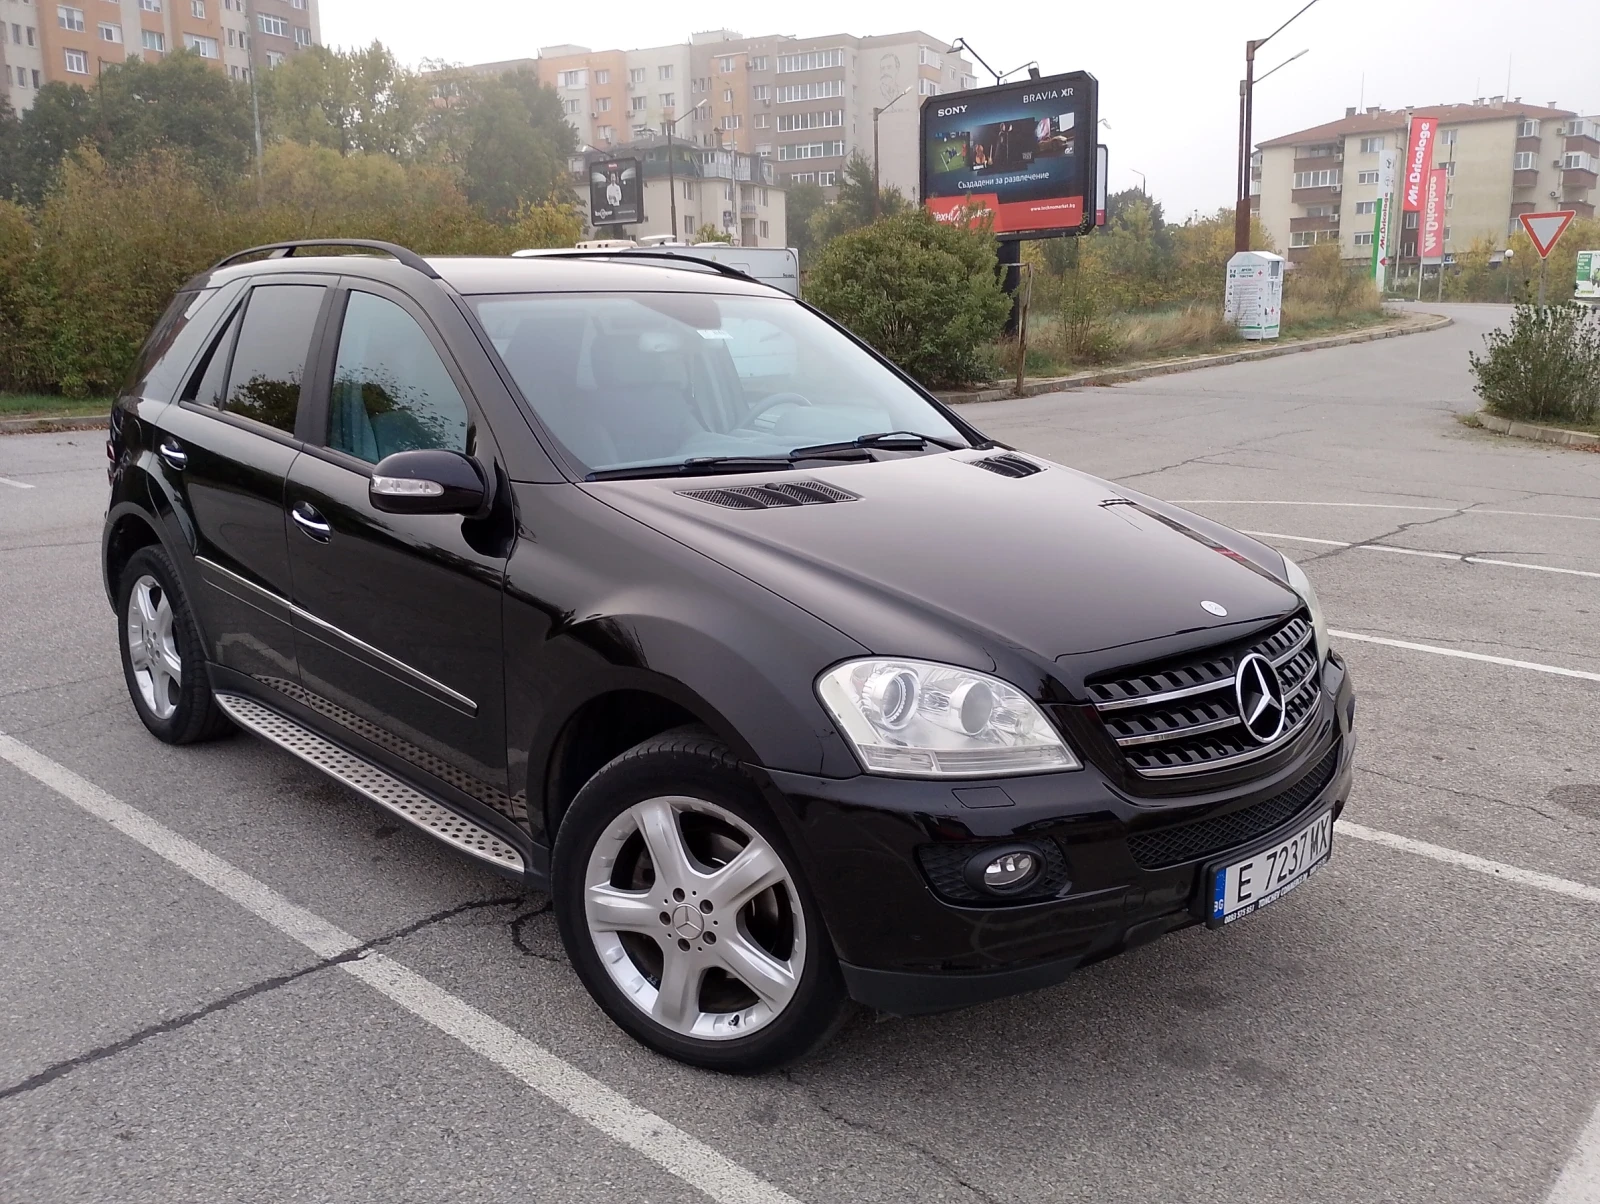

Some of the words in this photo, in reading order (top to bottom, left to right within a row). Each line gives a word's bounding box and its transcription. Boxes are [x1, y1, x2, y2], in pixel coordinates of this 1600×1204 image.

[1023, 90, 1058, 103] BRAVIA
[1061, 88, 1074, 97] XR
[938, 105, 968, 117] SONY
[958, 179, 994, 189] Създадени
[1004, 172, 1050, 185] развлечение
[1237, 863, 1253, 903] E
[1264, 830, 1308, 891] 7237
[1310, 815, 1330, 861] MX
[1213, 898, 1224, 912] BG
